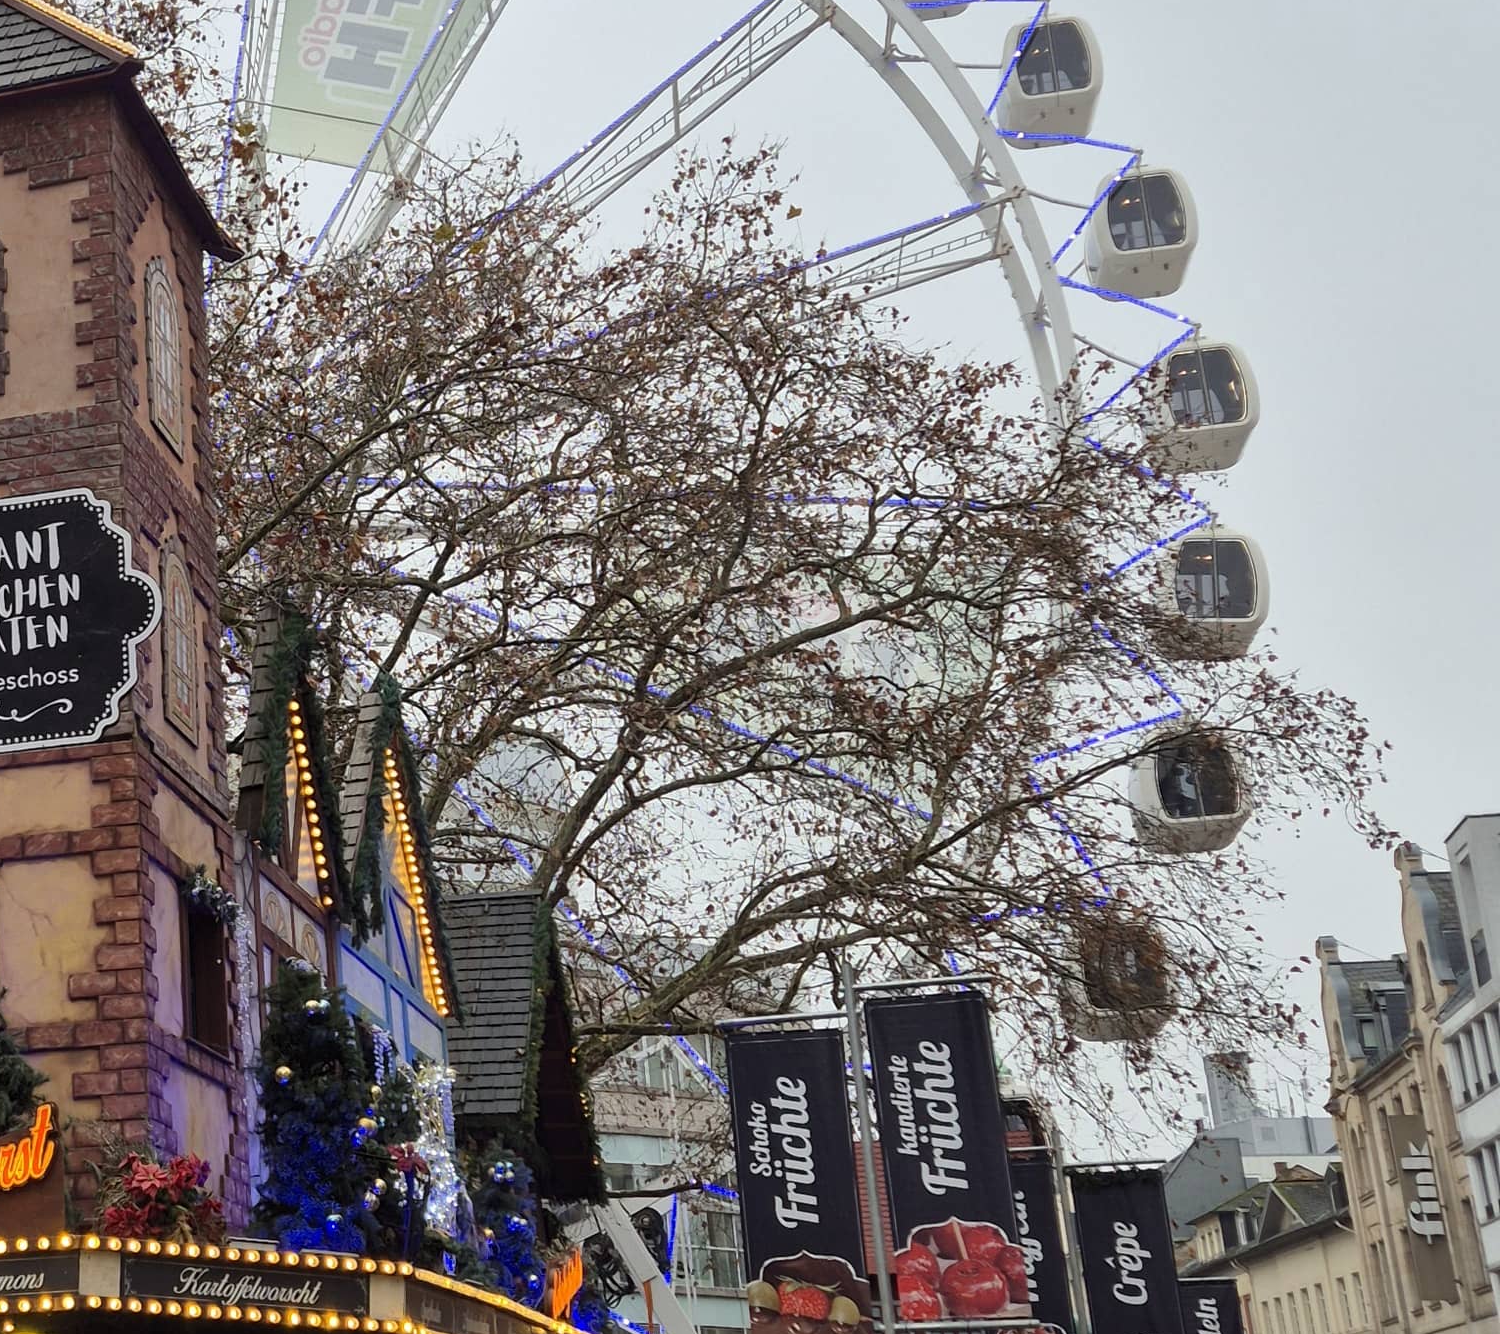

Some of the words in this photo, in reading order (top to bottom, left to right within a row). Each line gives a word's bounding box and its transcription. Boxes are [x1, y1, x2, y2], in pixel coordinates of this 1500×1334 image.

[747, 1101, 772, 1177] Schoko
[770, 1076, 820, 1228] Früchte
[888, 1055, 920, 1156] kandierte
[912, 1041, 969, 1195] Früchte
[1401, 1139, 1445, 1244] fink
[173, 1265, 323, 1307] Kartoffelworscht
[1103, 1221, 1152, 1305] Crêpe
